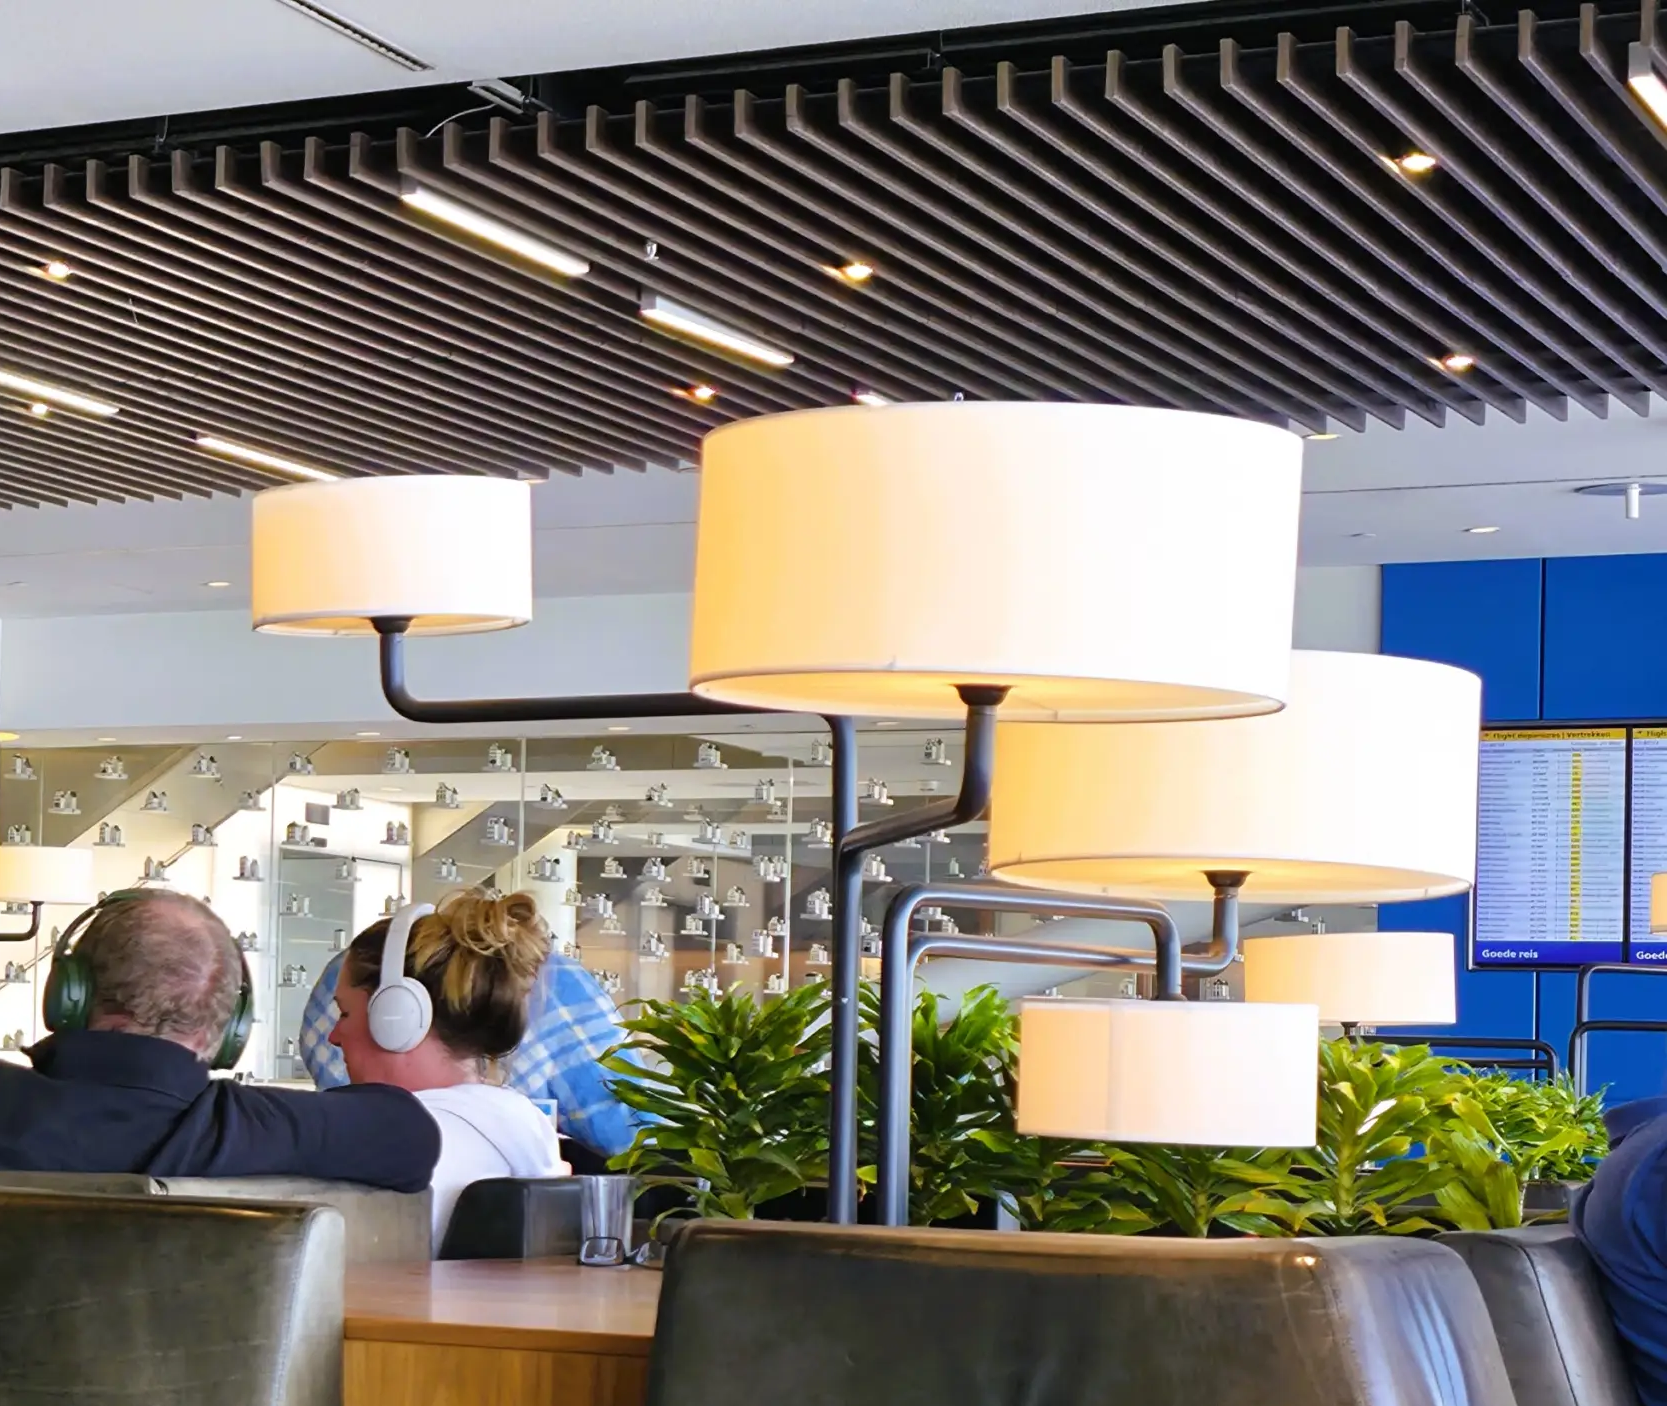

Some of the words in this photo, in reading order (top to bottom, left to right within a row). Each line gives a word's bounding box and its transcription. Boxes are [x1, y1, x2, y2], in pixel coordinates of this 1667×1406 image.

[1646, 729, 1667, 738] Fligh
[1482, 949, 1516, 959] Goede
[1519, 949, 1538, 959] reis
[1635, 950, 1667, 960] Goed
